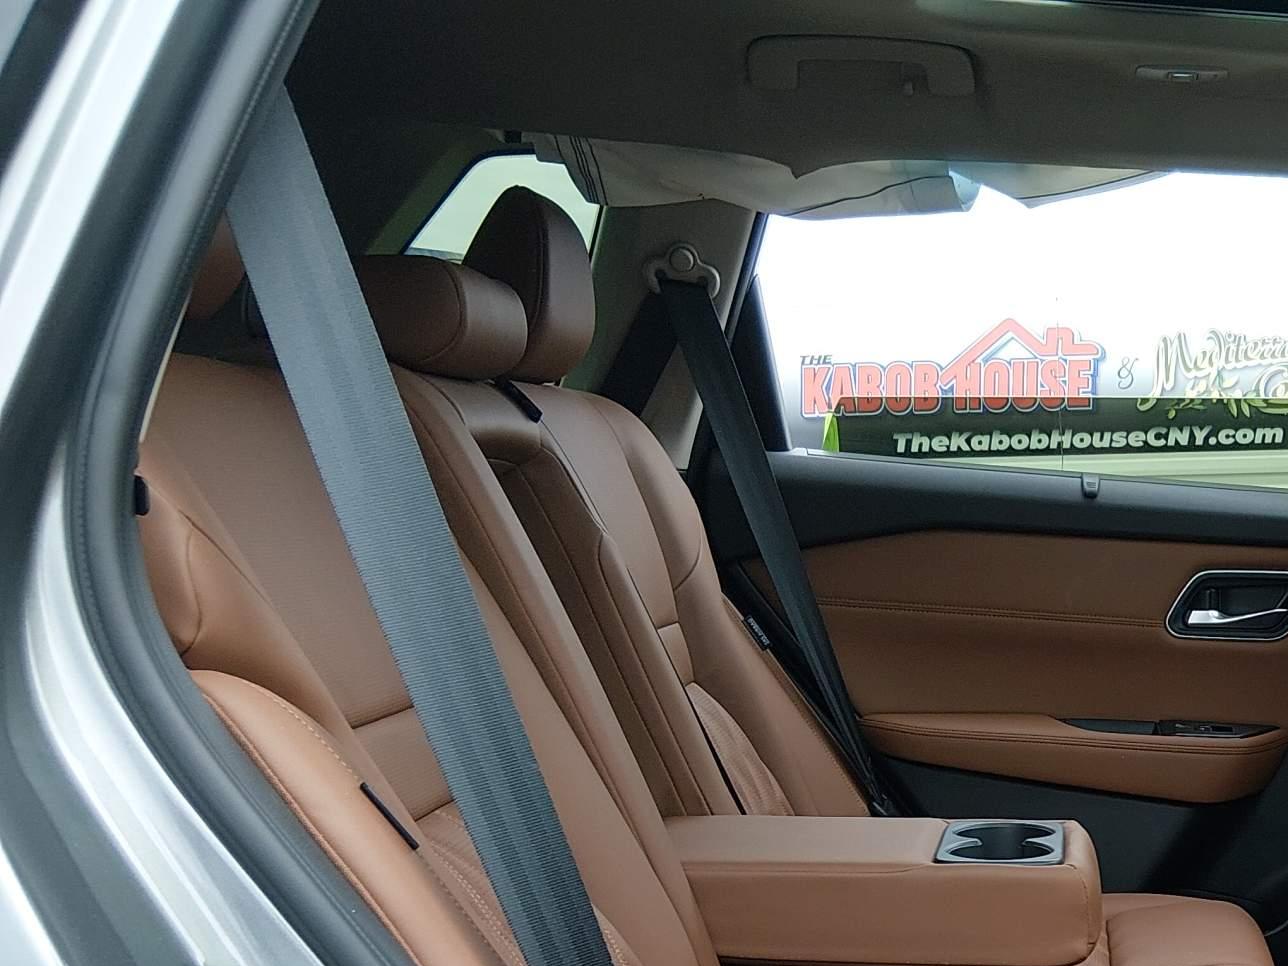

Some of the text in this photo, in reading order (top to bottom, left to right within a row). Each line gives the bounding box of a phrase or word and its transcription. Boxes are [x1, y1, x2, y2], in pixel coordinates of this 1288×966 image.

[800, 354, 832, 366] THE
[1118, 356, 1139, 390] &
[801, 357, 1097, 417] KABOB HOUSE
[893, 426, 1284, 454] TheKabobHouseCNY.com
